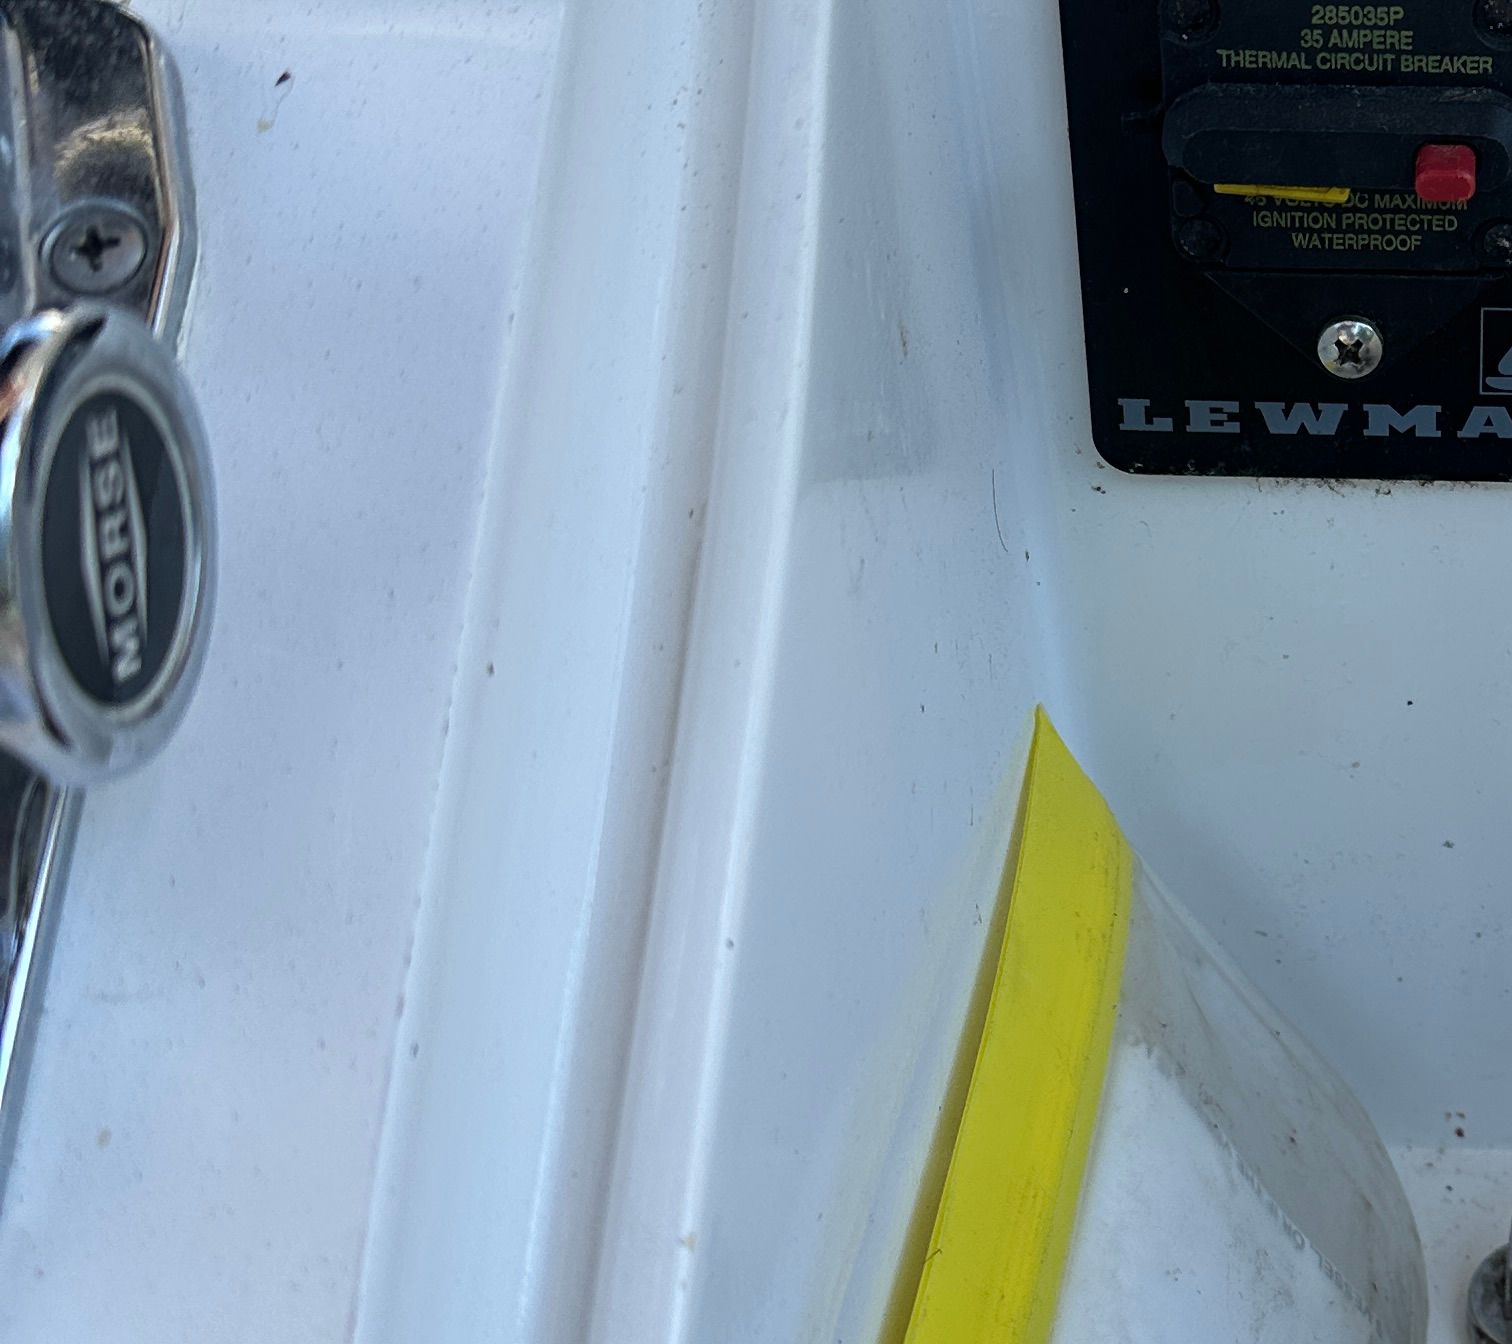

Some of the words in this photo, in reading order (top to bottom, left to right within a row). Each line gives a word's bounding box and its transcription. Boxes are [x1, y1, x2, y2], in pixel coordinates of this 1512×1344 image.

[1311, 5, 1405, 26] 285035P
[1300, 28, 1323, 49] 35
[1328, 29, 1413, 50] AMPERE
[1216, 49, 1312, 70] THERMAL
[1316, 52, 1395, 72] CIRCUIT
[1401, 55, 1493, 75] BREAKER
[1253, 210, 1336, 229] IGNITION
[1342, 213, 1458, 232] PROTECTED
[1292, 232, 1423, 251] WATERPROOF
[86, 409, 142, 684] MORSE
